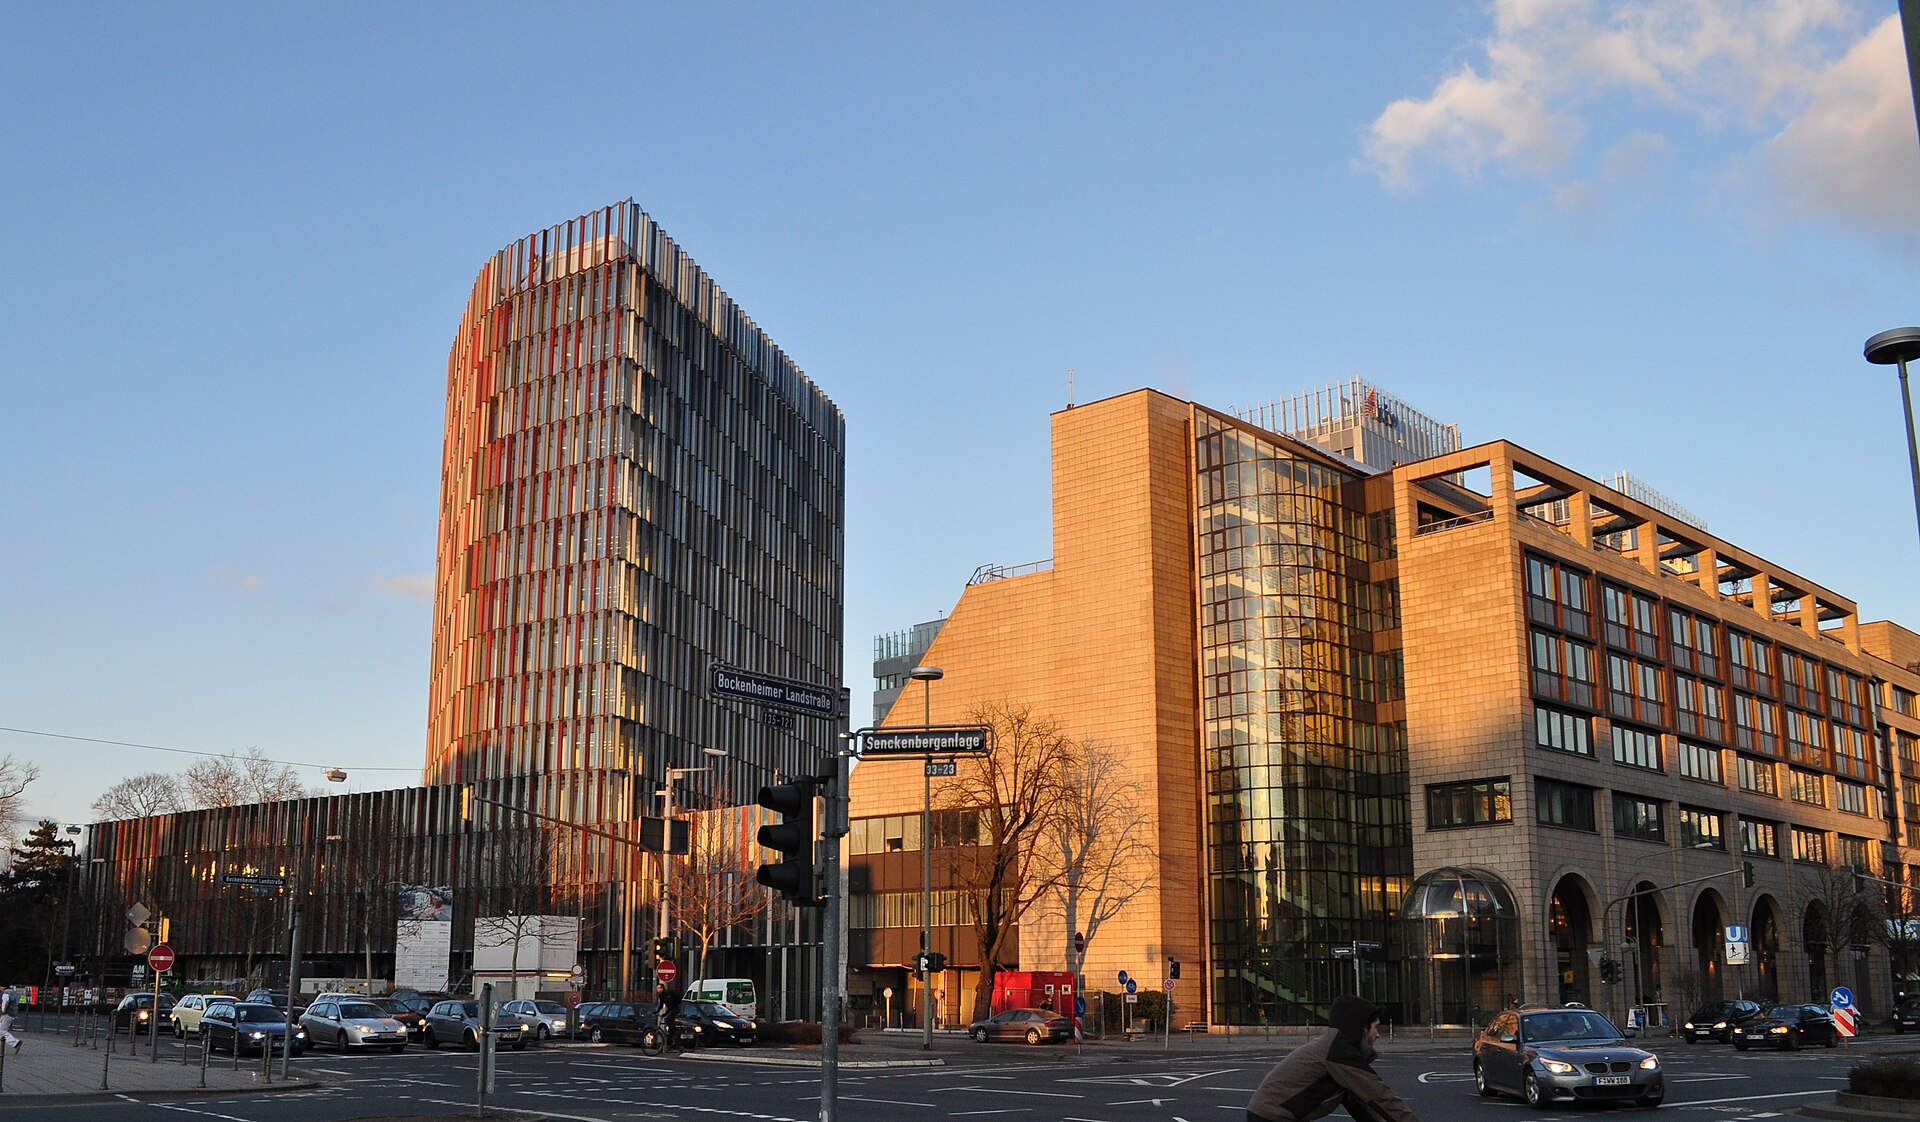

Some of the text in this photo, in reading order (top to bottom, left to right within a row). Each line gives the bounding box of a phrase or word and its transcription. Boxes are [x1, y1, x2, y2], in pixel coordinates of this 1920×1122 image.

[718, 673, 831, 709] Bockenheimer Landstraße
[763, 713, 794, 729] 135-121
[866, 732, 980, 751] Senckenberganlage
[926, 764, 955, 775] 33-23
[1725, 926, 1741, 942] U
